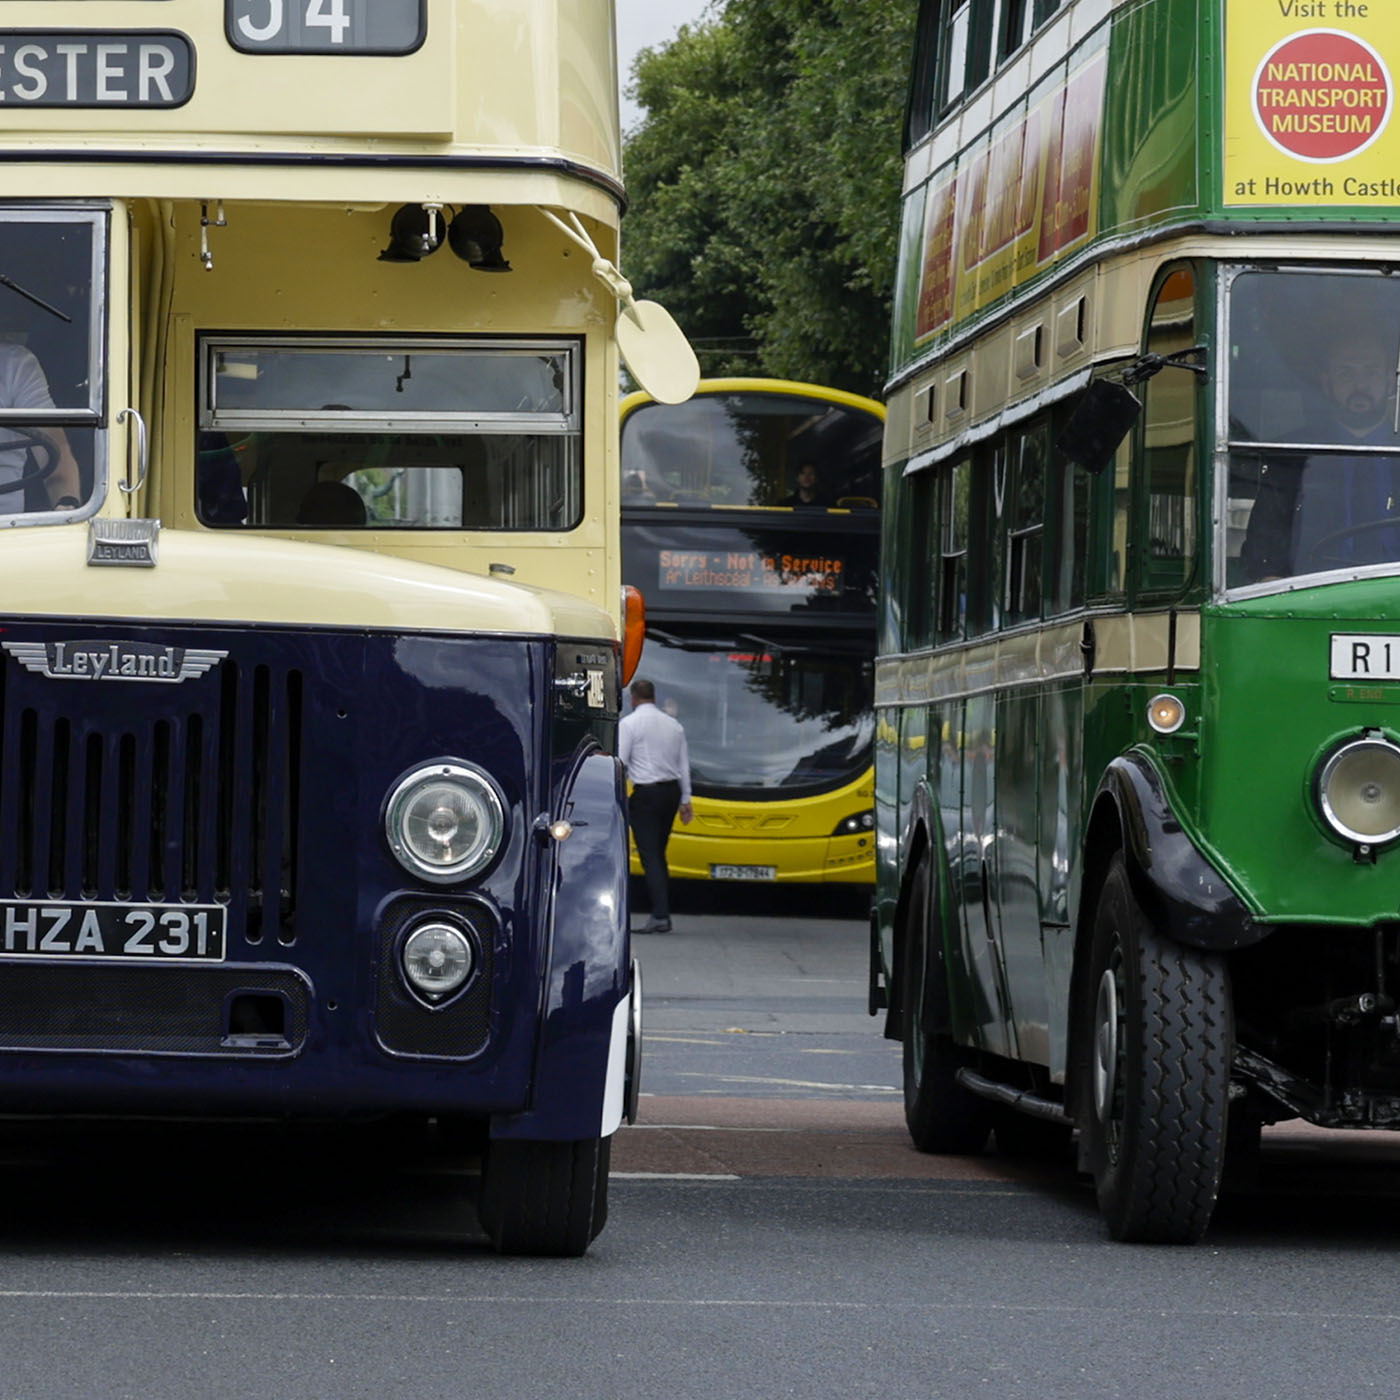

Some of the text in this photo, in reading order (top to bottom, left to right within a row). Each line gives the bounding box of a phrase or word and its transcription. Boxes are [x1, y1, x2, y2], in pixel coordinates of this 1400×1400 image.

[1278, 0, 1369, 17] Visit the
[1267, 63, 1379, 82] NATIONAL
[1259, 89, 1385, 108] TRANSPORT
[1272, 114, 1371, 134] MUSEUM
[1234, 179, 1256, 195] at
[1265, 177, 1334, 196] Howth
[97, 545, 148, 560] LEYLAND
[660, 551, 707, 569] Sorry
[726, 552, 755, 571] Not
[781, 555, 843, 573] Service
[53, 642, 176, 680] Leyland
[4, 907, 208, 955] HZA 231
